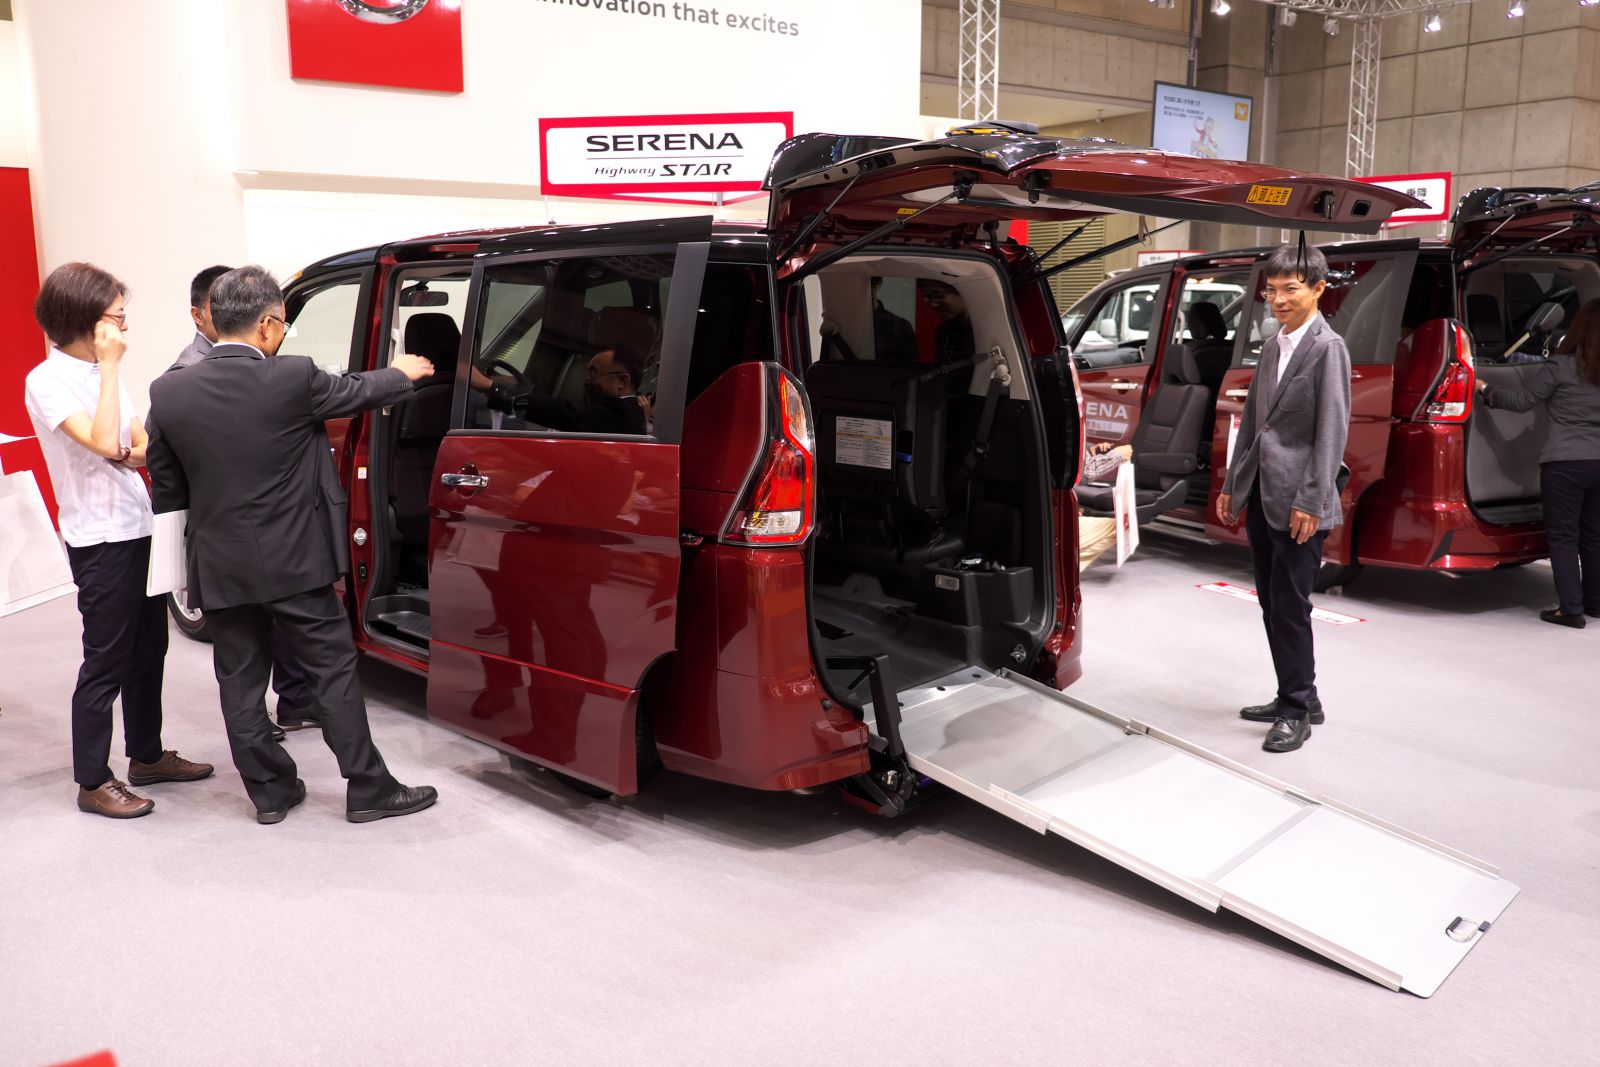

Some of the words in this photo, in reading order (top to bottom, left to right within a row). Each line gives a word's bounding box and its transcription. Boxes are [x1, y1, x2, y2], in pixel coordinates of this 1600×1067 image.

[672, 3, 719, 26] that
[726, 13, 800, 36] excites
[586, 132, 744, 153] SERENA
[594, 166, 656, 178] Highway
[660, 163, 732, 177] STAR
[1086, 402, 1129, 420] ENA
